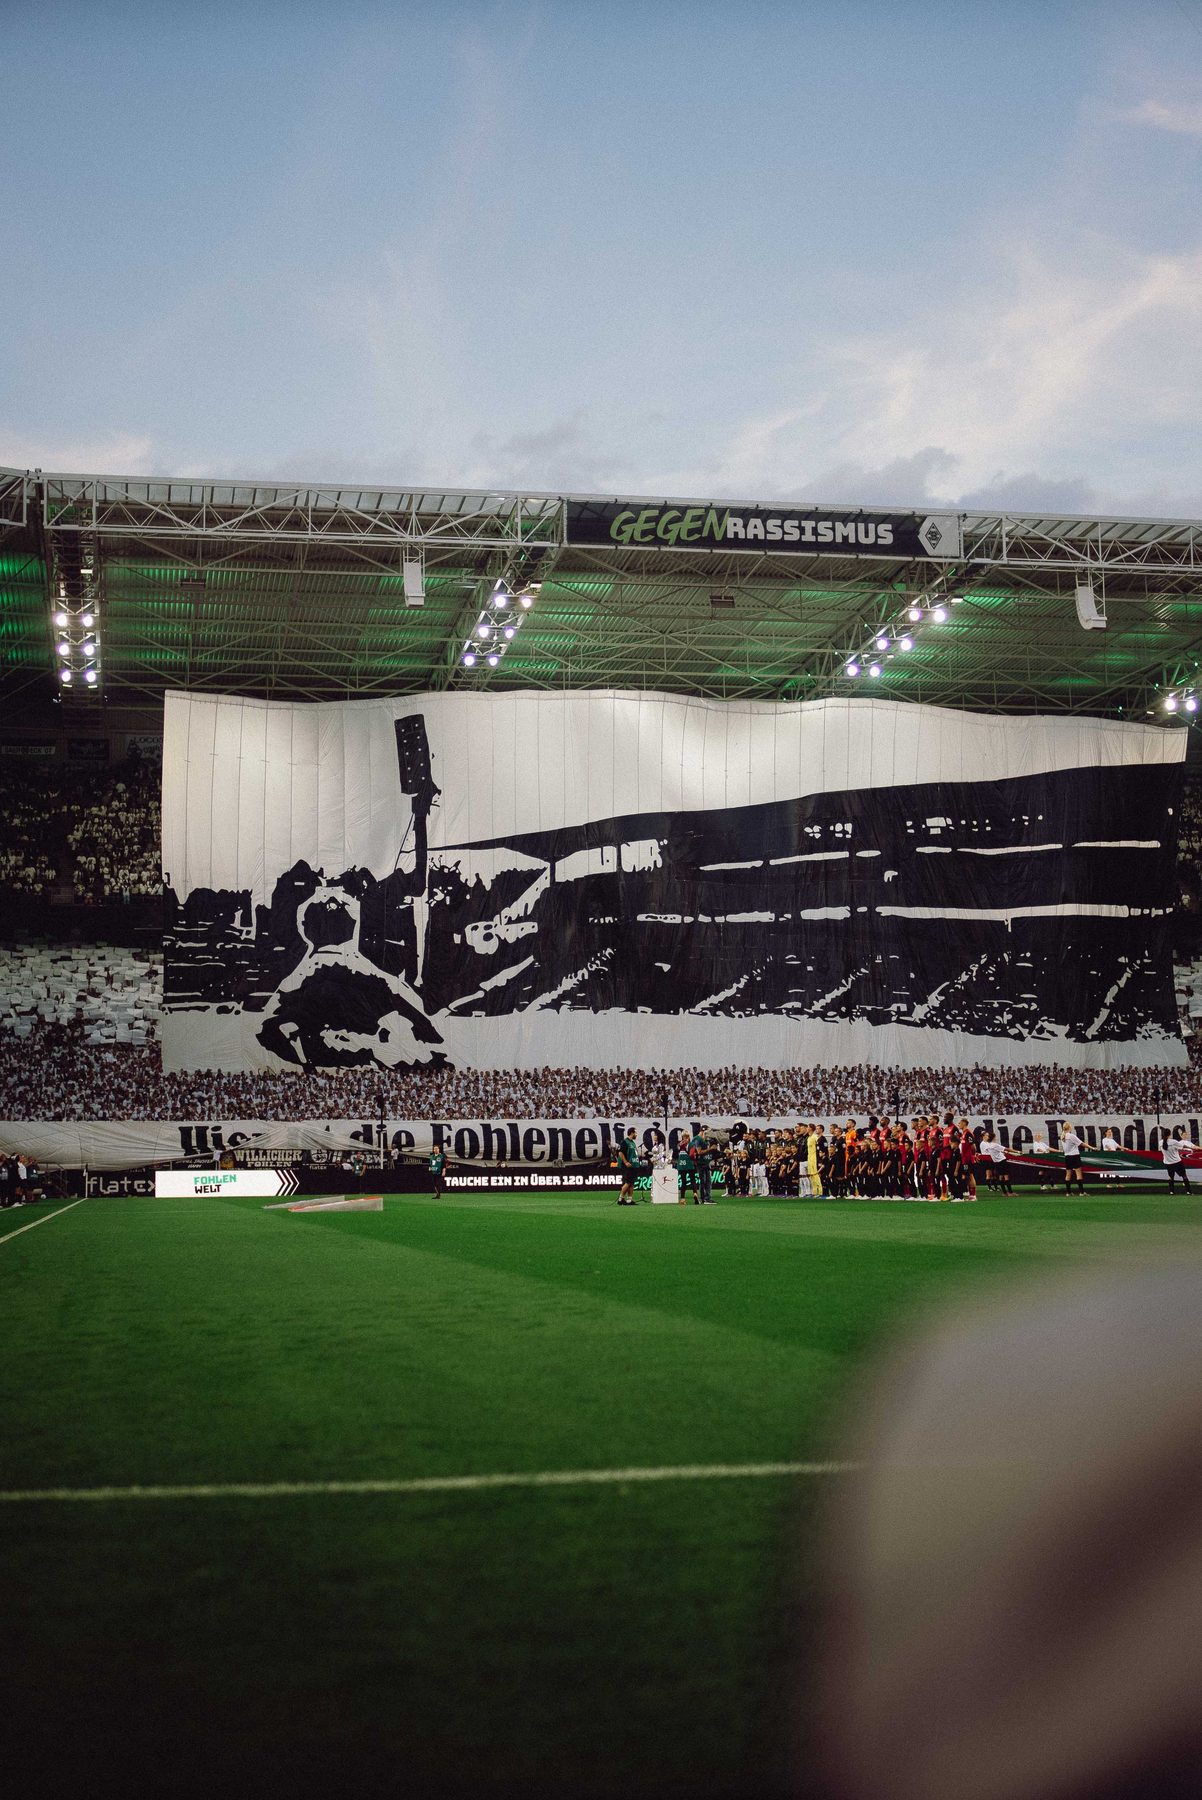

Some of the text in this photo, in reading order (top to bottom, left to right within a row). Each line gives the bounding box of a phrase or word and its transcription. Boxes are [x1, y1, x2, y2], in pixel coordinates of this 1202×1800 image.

[609, 508, 894, 545] GEGEN RASSISMUS
[233, 1149, 303, 1161] WILLICHER
[194, 1174, 237, 1185] FOHLEN
[444, 1176, 489, 1187] TAUCHE
[490, 1176, 512, 1186] EIN
[513, 1176, 529, 1186] IN
[530, 1173, 561, 1186] ÜBER
[563, 1175, 583, 1186] 120
[585, 1175, 623, 1186] JAHRE
[194, 1184, 222, 1194] WELT
